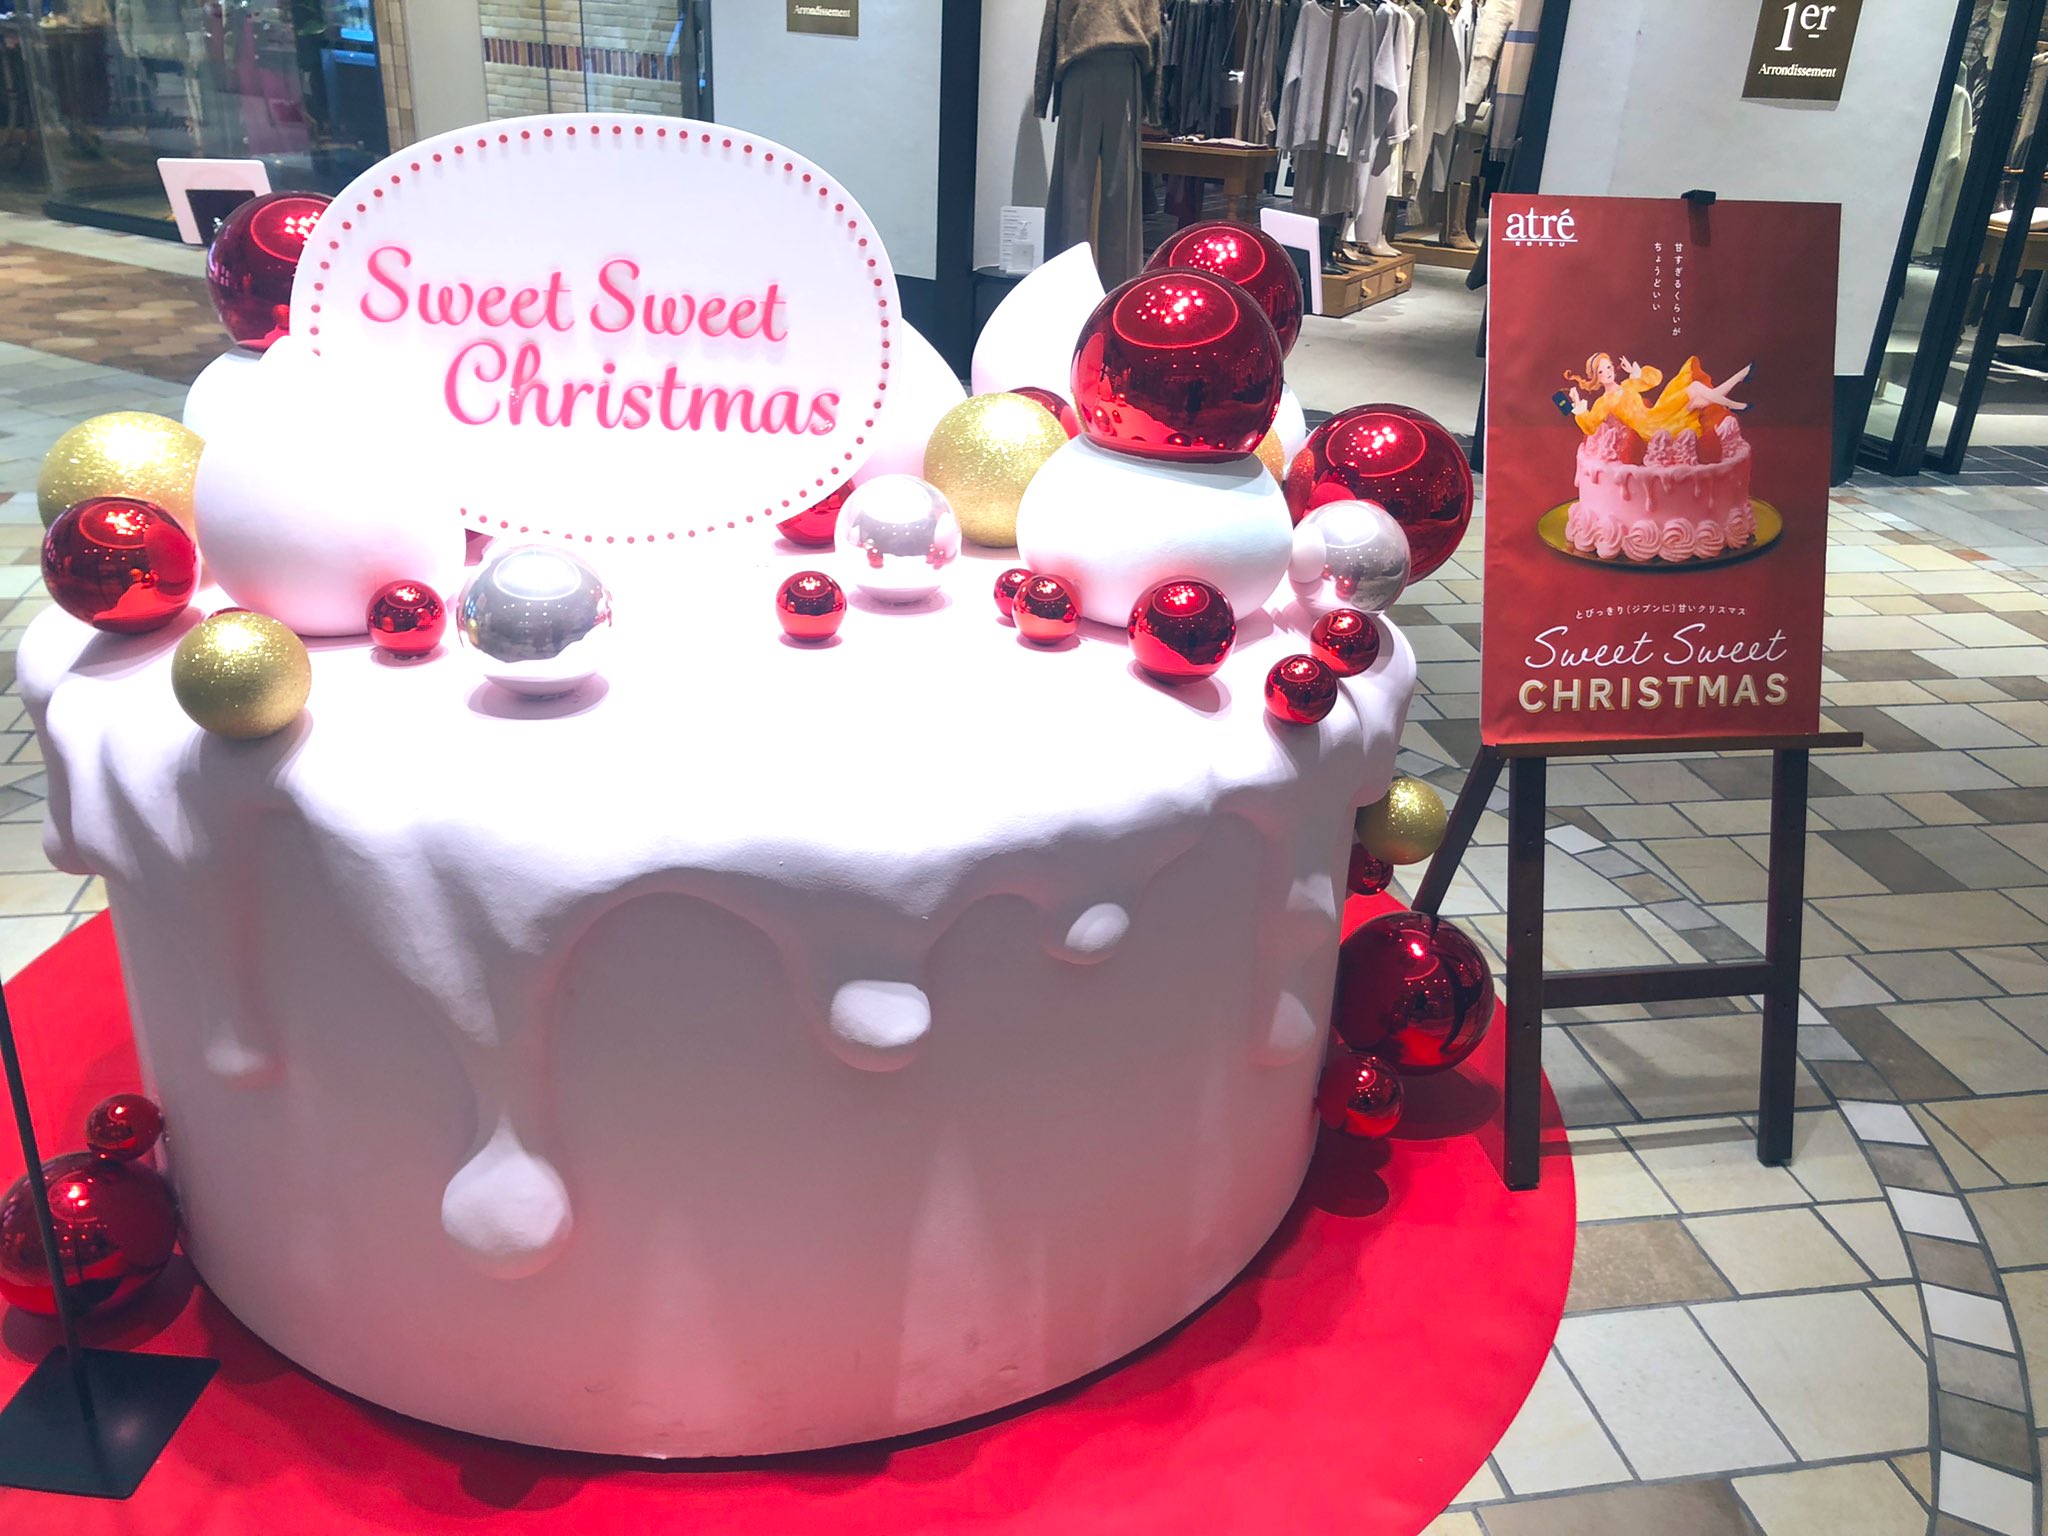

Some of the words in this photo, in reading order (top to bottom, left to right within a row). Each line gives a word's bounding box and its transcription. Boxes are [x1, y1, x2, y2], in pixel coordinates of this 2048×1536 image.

[793, 5, 850, 17] Arrondissement
[1774, 2, 1837, 51] 1er
[1758, 63, 1837, 78] Arrondissement
[1505, 207, 1575, 239] atré
[360, 246, 575, 332] Sweet
[590, 259, 788, 342] Sweet
[1652, 242, 1662, 311] ちょうどいい
[1672, 242, 1683, 336] 甘すぎるくらいが
[444, 340, 840, 436] Christmas
[1525, 625, 1653, 669] Sweet
[1663, 623, 1787, 665] Sweet
[1518, 673, 1790, 713] CHRISTMAS
